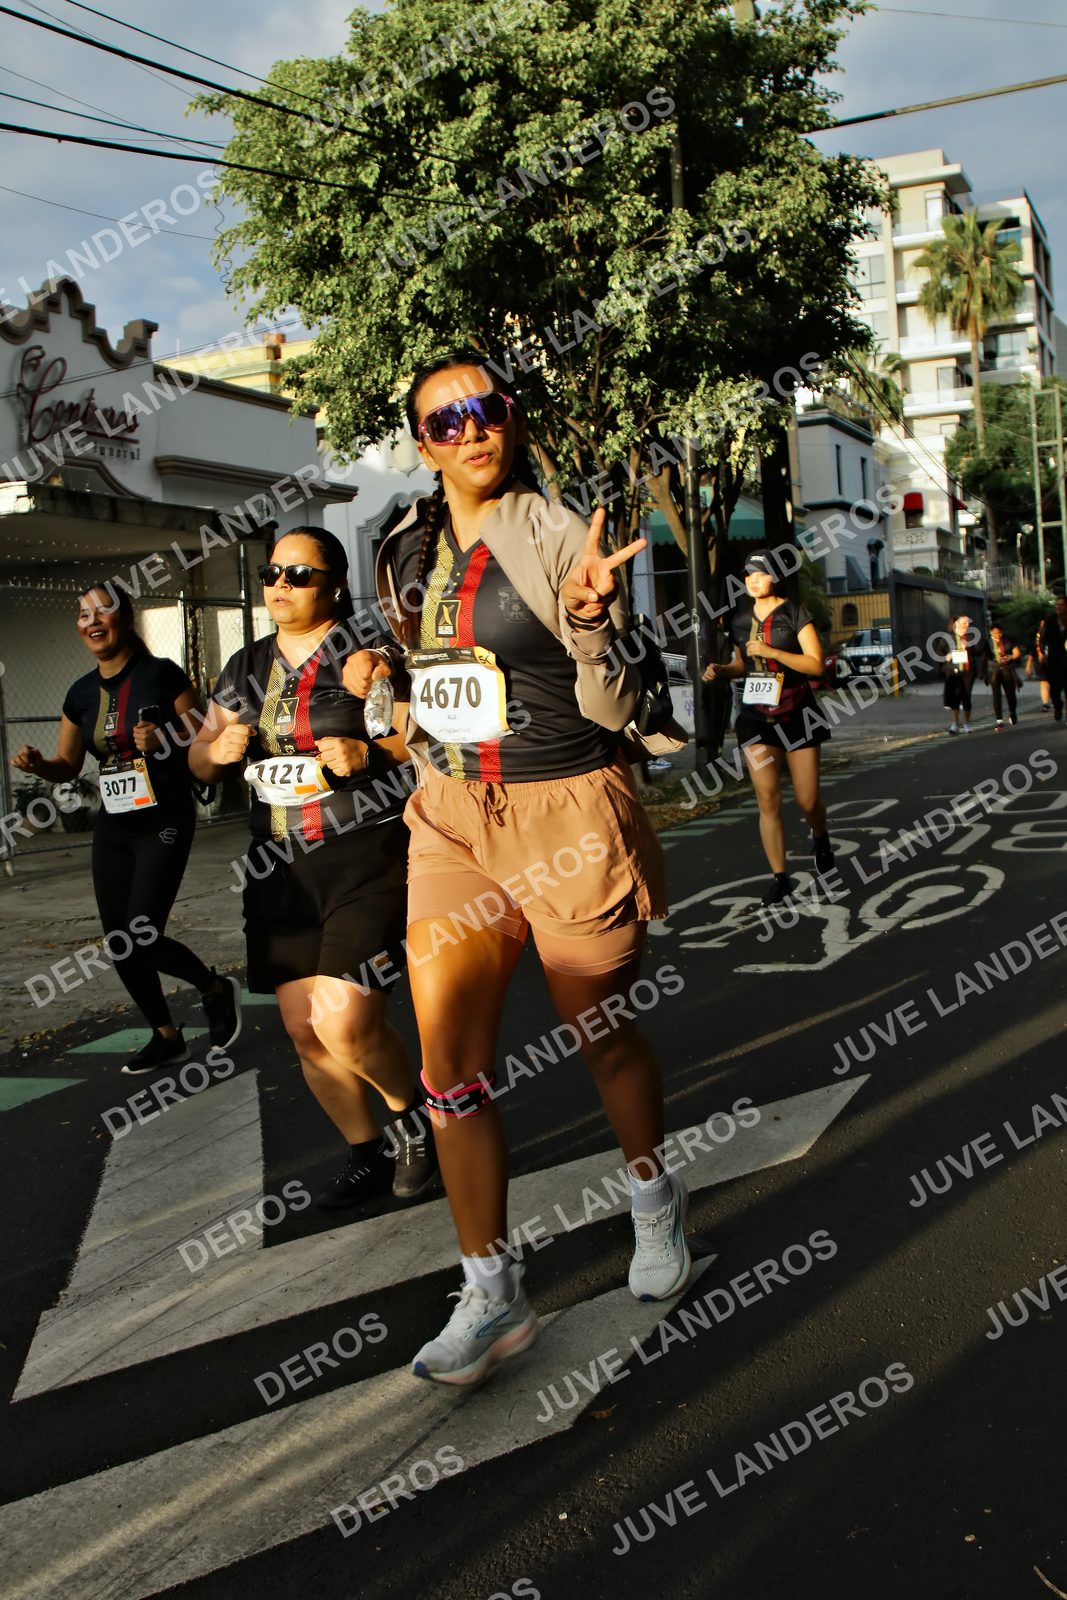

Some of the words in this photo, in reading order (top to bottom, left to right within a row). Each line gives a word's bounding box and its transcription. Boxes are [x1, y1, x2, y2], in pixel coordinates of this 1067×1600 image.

[420, 676, 481, 709] 4670
[749, 682, 772, 692] 3073
[104, 777, 136, 796] 3077
